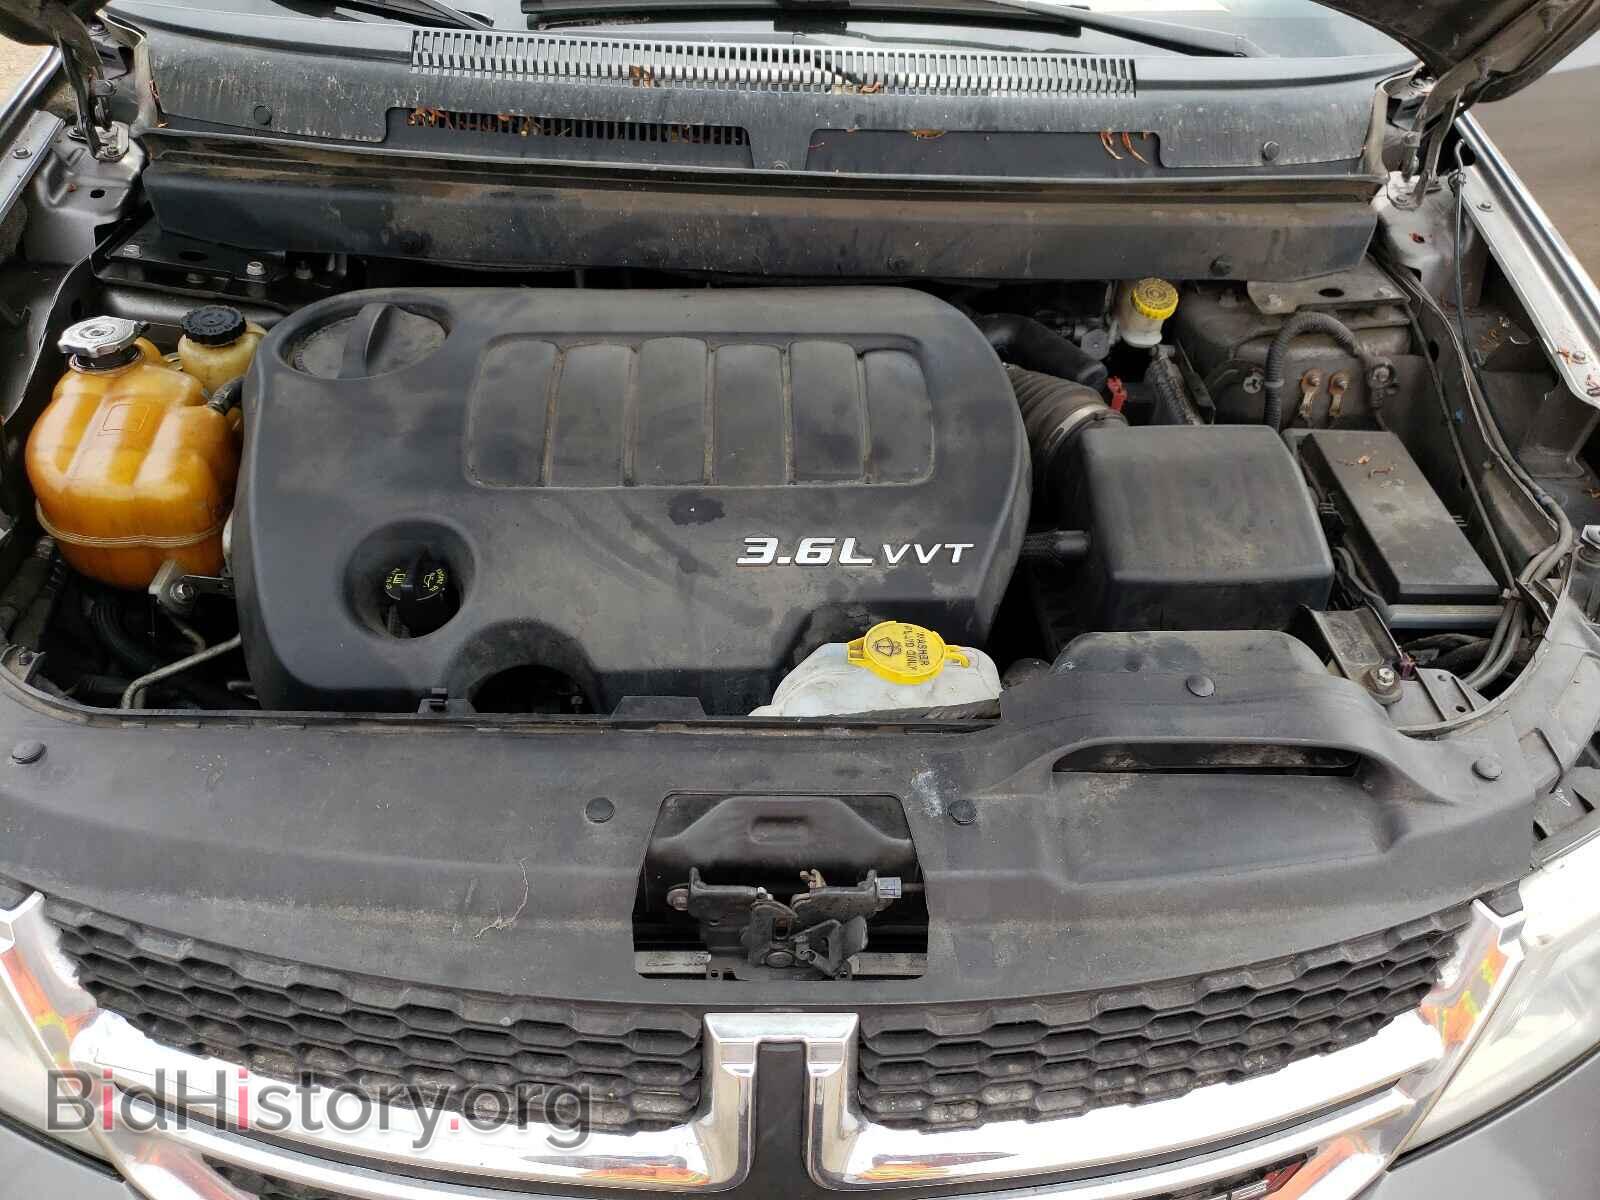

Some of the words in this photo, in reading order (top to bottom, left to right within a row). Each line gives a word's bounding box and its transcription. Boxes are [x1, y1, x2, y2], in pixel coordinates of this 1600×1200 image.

[736, 537, 873, 566] 3.6L
[882, 543, 974, 566] VVT
[906, 650, 917, 671] ONLY
[917, 632, 930, 666] WASHER
